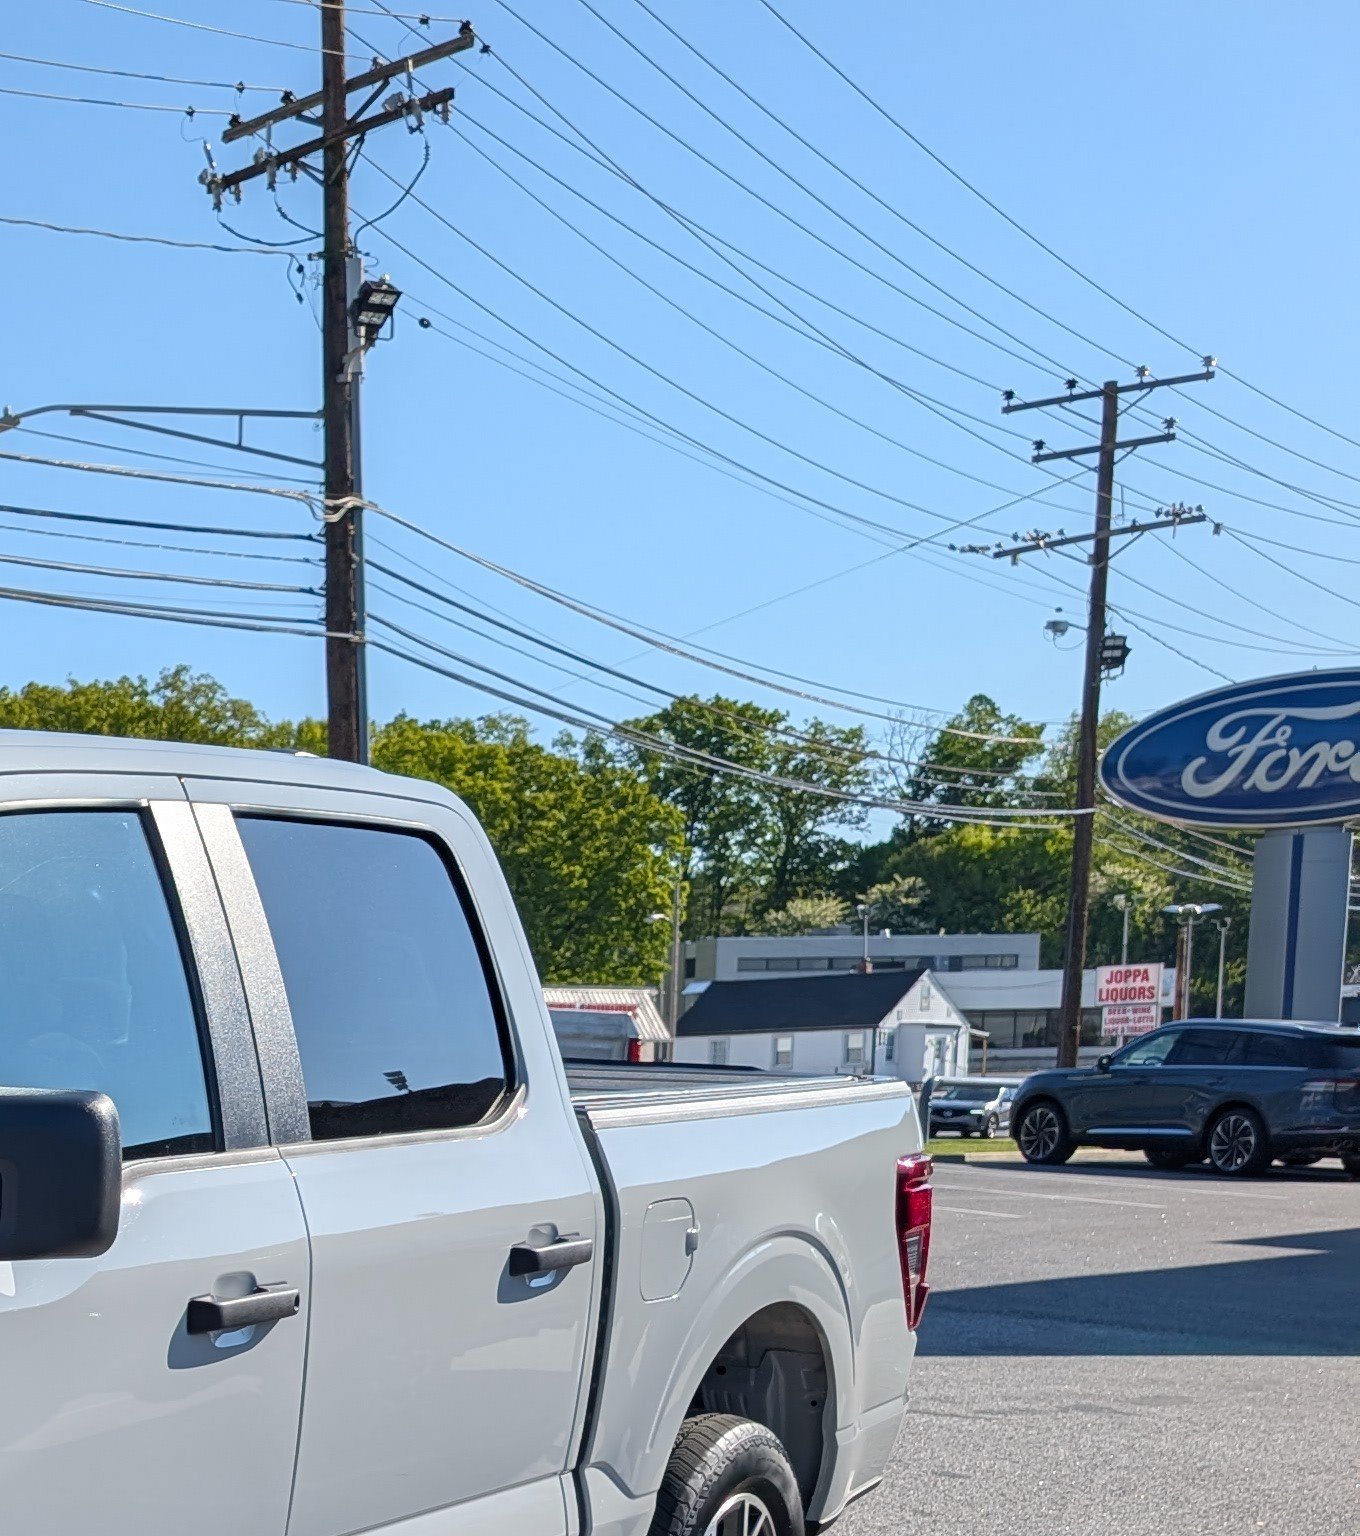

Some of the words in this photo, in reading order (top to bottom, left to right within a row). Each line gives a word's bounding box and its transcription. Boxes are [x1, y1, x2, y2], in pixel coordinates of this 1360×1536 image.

[1181, 701, 1360, 798] For
[1106, 968, 1150, 984] JOPPA
[1098, 986, 1155, 1002] LIQUORS
